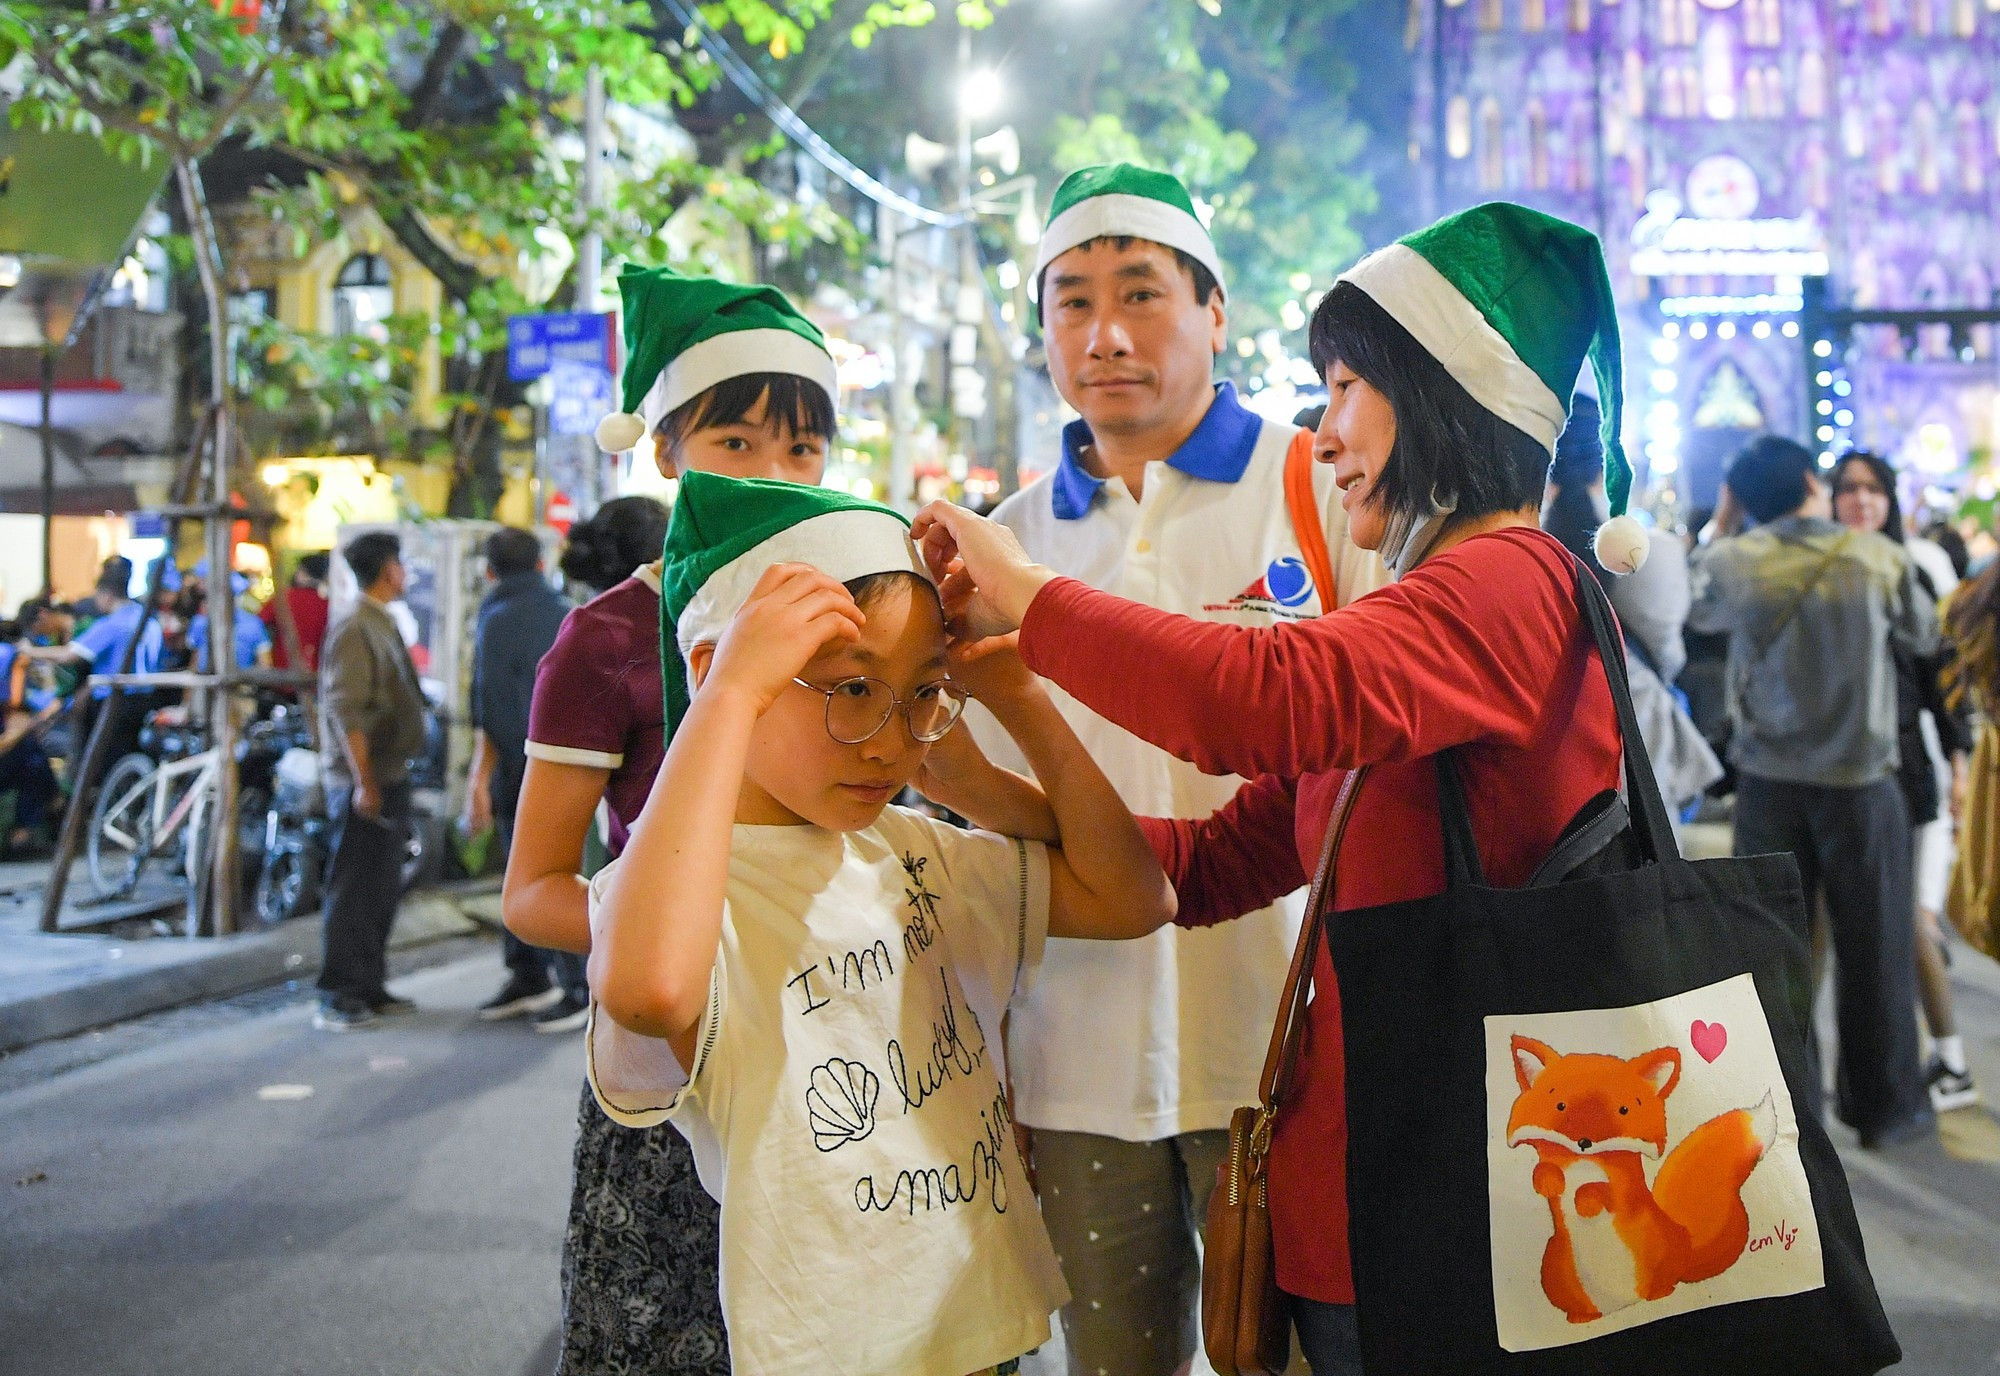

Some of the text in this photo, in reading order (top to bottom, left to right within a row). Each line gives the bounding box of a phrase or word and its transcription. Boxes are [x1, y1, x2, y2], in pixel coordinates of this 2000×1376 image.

[787, 939, 894, 1016] I'm
[854, 1080, 1011, 1216] amazin
[1749, 1235, 1773, 1253] em
